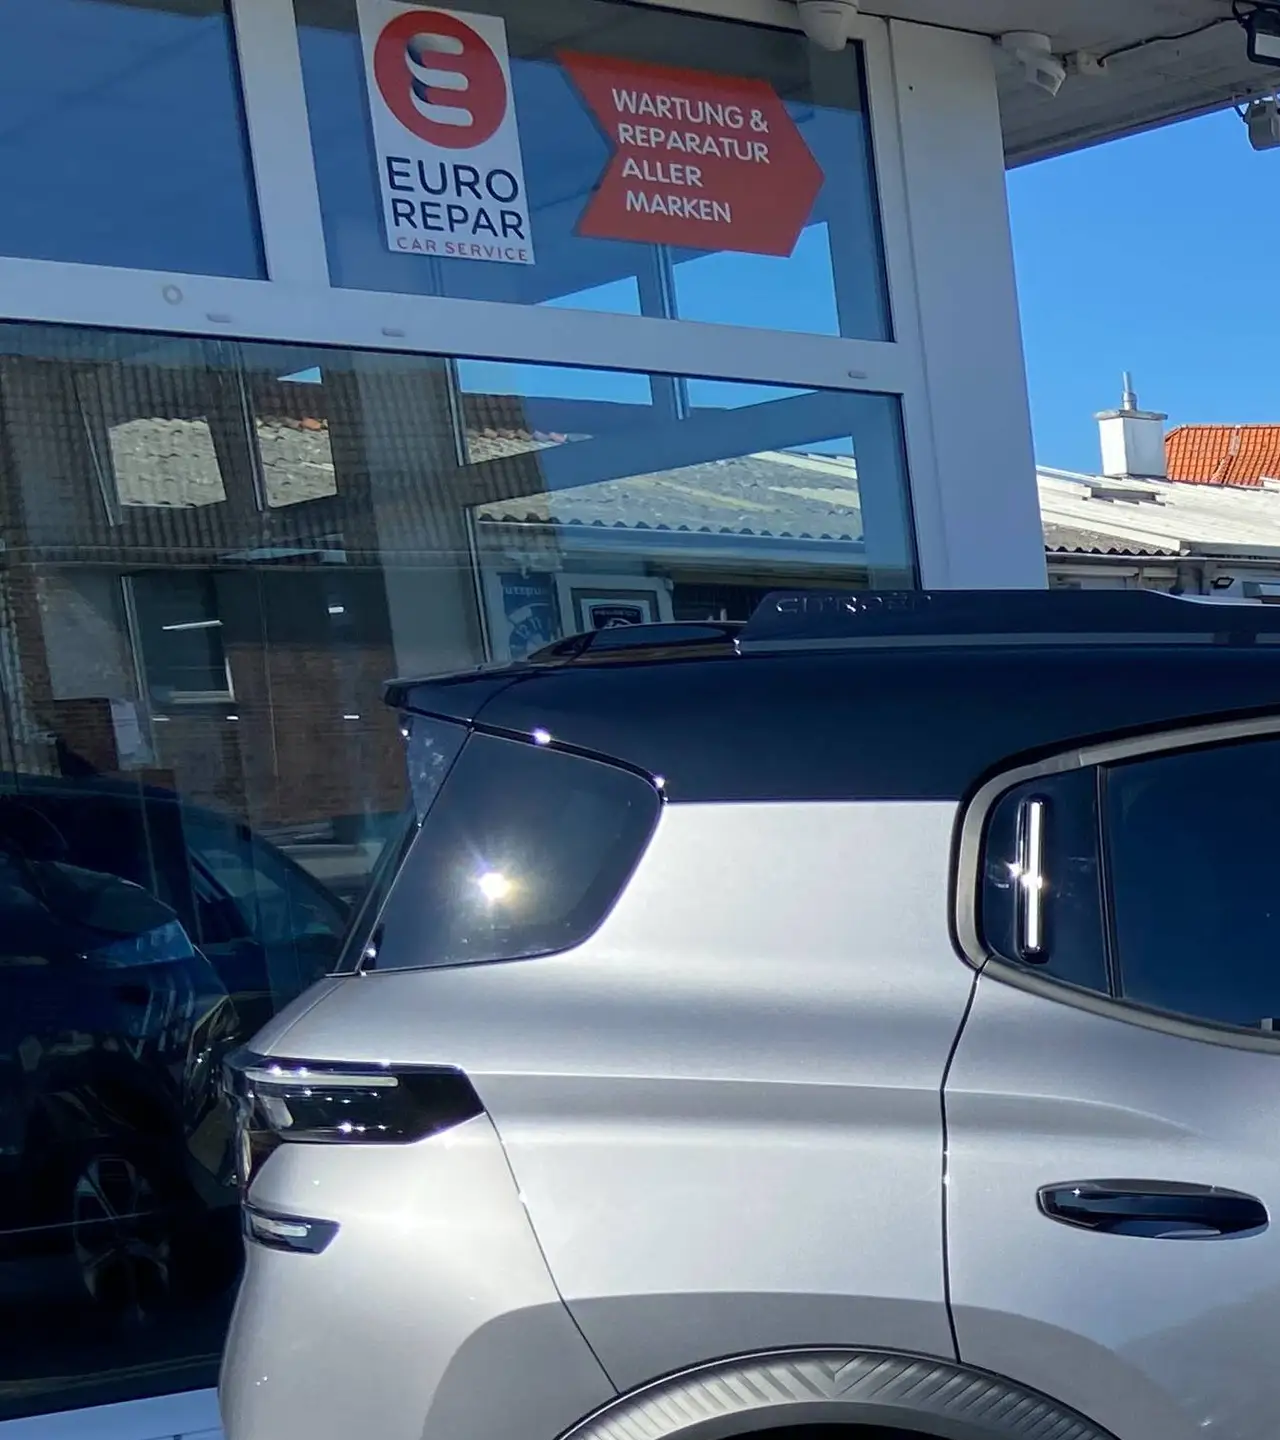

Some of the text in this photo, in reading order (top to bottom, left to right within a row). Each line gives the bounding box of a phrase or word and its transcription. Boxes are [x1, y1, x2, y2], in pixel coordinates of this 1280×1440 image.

[611, 88, 769, 133] WARTUNG &
[617, 123, 770, 164] REPARATUR
[386, 156, 519, 203] EURO
[622, 157, 703, 187] ALLER
[391, 198, 525, 240] REPAR
[626, 190, 732, 223] MARKEN
[396, 237, 528, 262] CAR SERVICE
